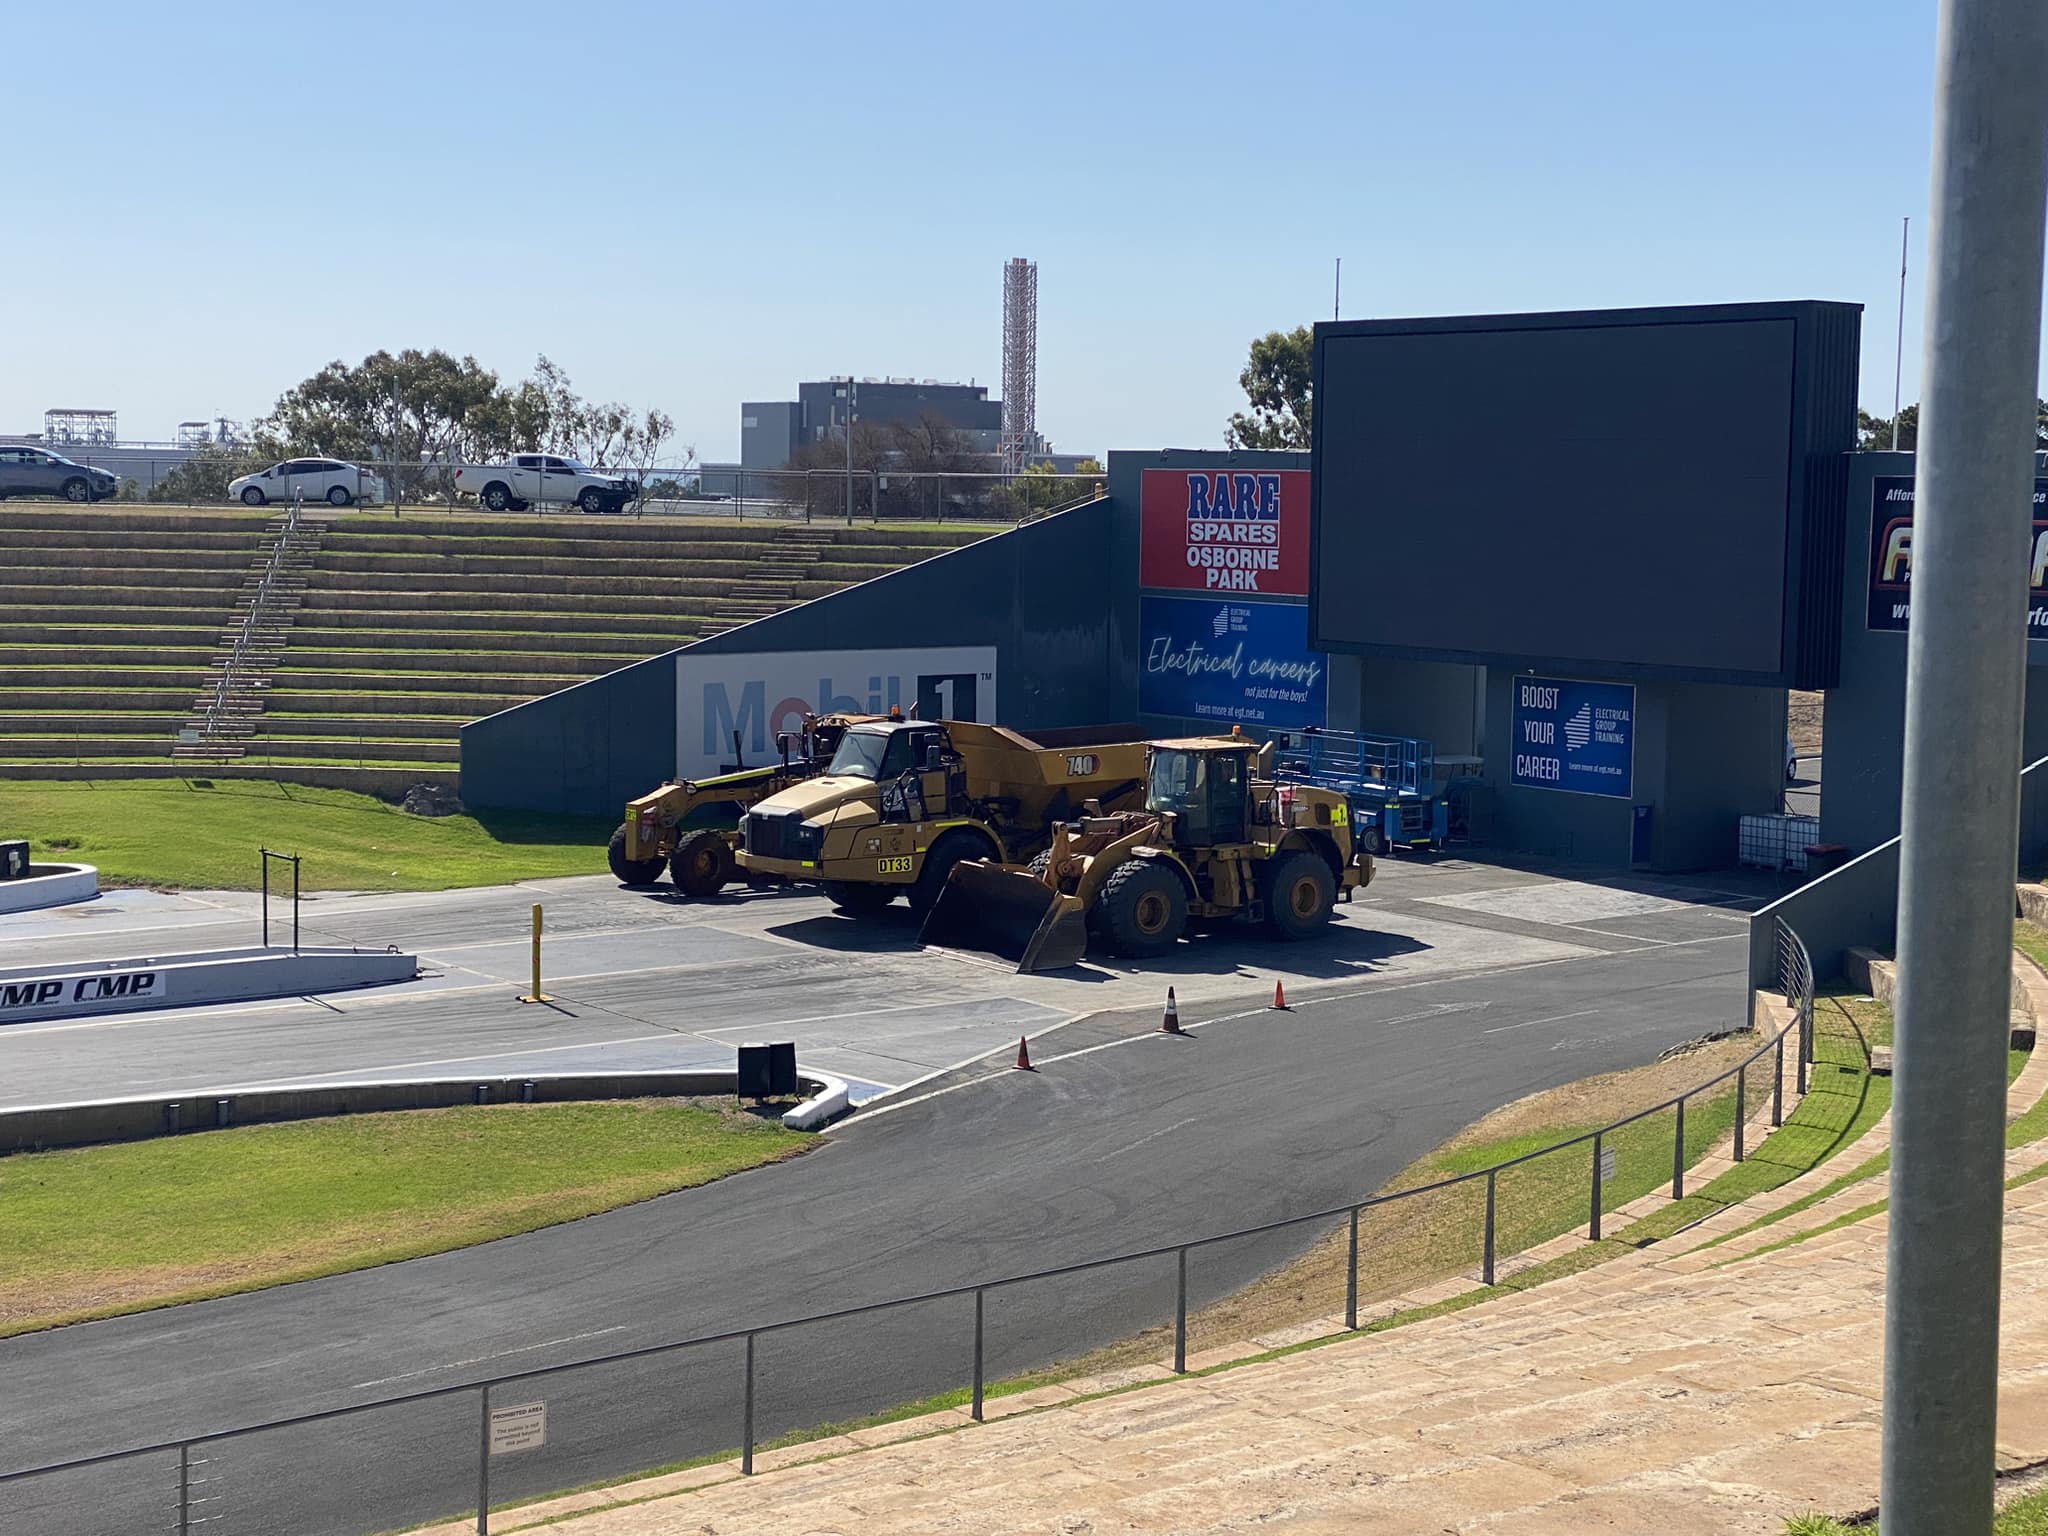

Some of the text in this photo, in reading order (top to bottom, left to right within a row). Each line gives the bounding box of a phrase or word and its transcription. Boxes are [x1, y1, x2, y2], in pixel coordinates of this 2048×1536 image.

[1187, 473, 1280, 520] RARE
[1190, 524, 1276, 543] SPARES
[1187, 547, 1279, 570] OSBORNE
[1206, 569, 1258, 590] PARK
[1147, 636, 1320, 686] Electrical careers
[1244, 686, 1309, 703] not just for the boys!
[1521, 685, 1559, 710] BOOST
[1195, 702, 1211, 714] Learn
[1211, 705, 1227, 716] more
[1227, 706, 1234, 717] at
[1595, 708, 1629, 721] ELECTRICAL
[1524, 720, 1554, 745] YOUR
[1595, 719, 1616, 731] GROUP
[1595, 731, 1624, 744] TRAINING
[1067, 756, 1093, 776] 740
[1516, 754, 1560, 780] CAREER
[880, 858, 910, 872] DT33
[0, 981, 63, 1005] MP
[73, 973, 155, 1002] CMP
